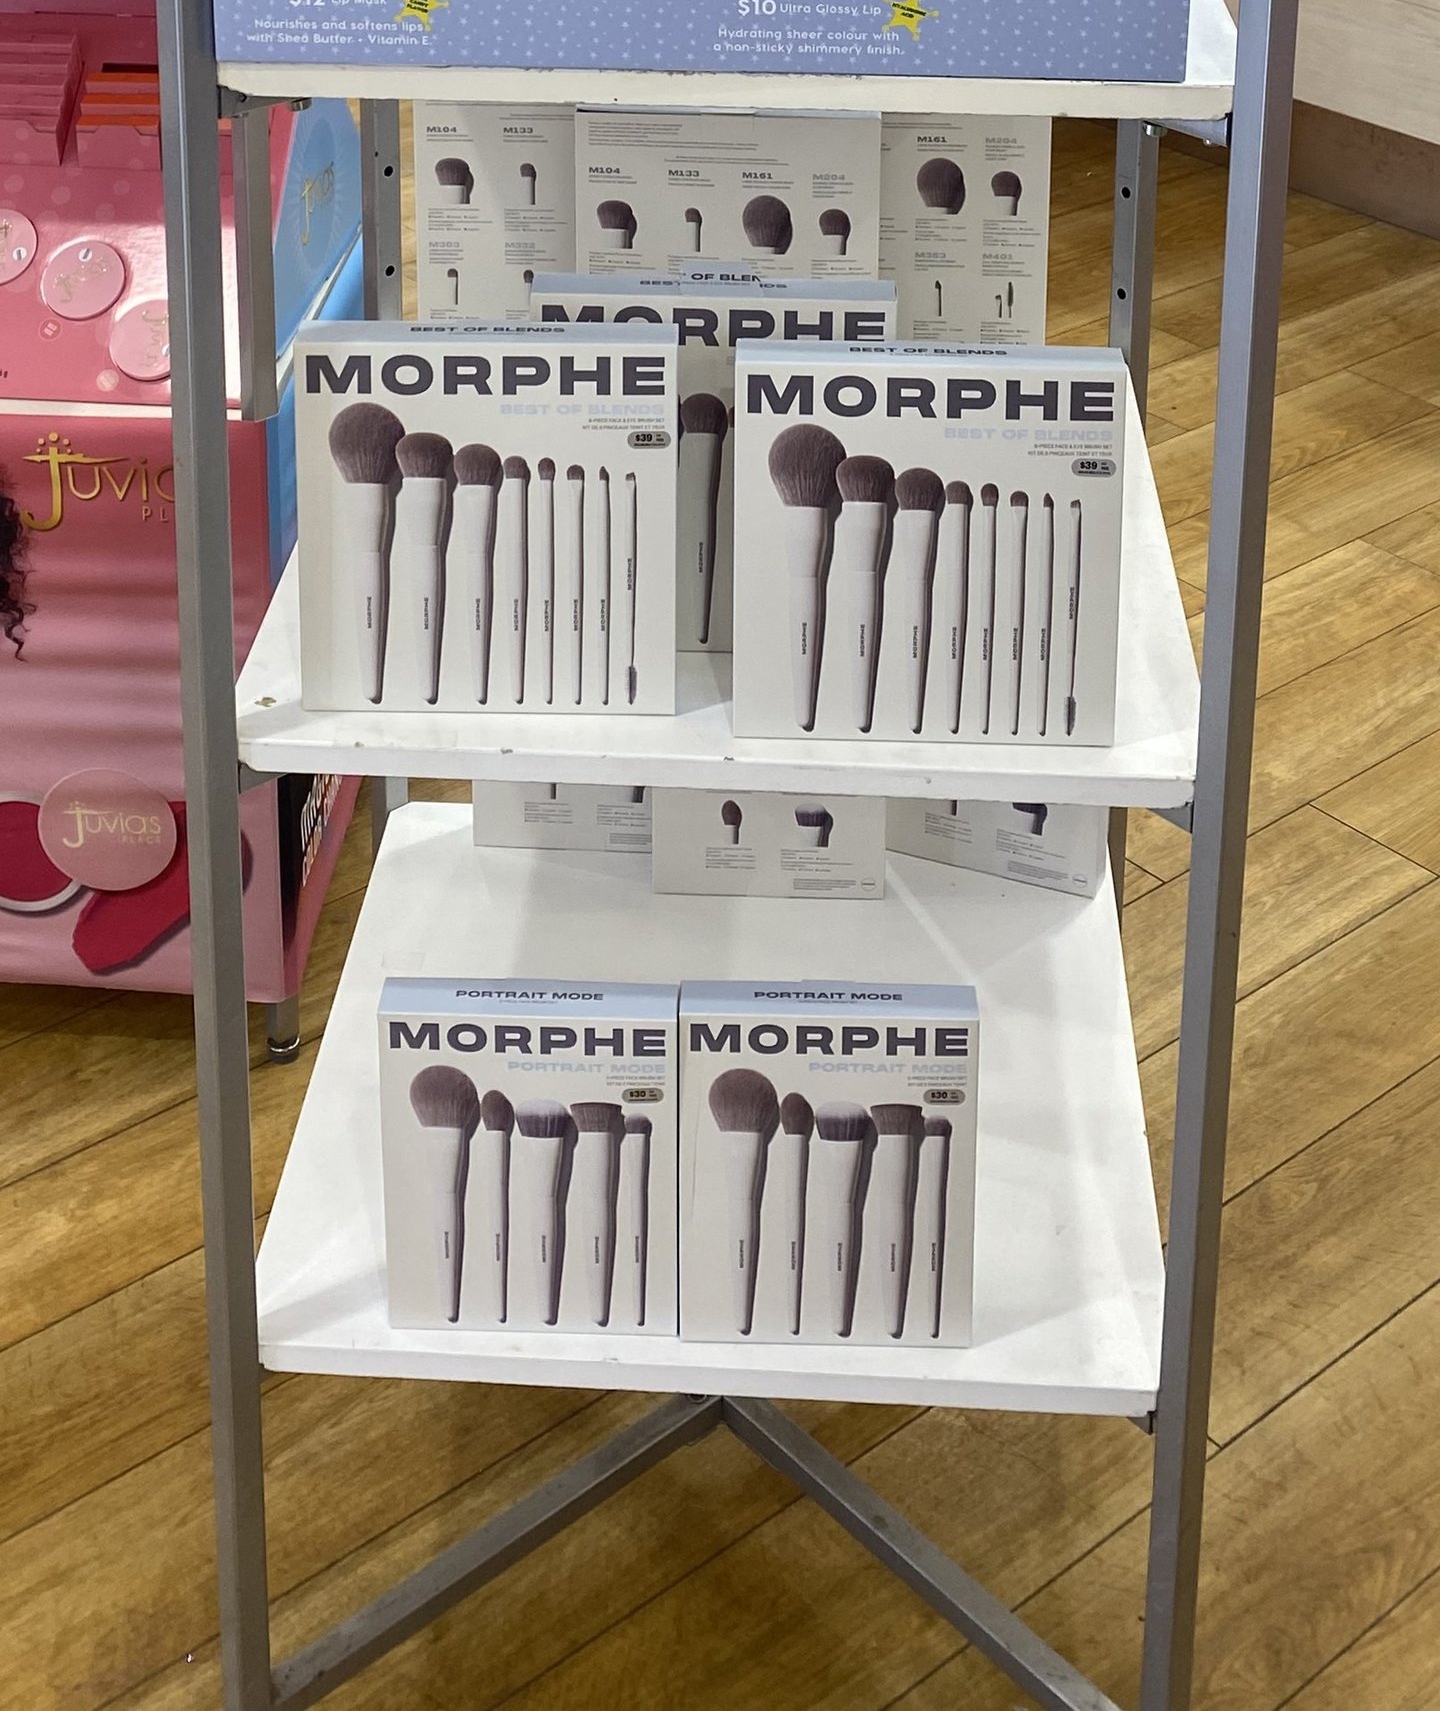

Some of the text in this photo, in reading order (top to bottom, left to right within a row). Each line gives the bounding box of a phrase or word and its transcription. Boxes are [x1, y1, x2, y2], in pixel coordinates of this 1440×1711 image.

[780, 3, 812, 14] Ultra
[815, 3, 858, 17] Glossy
[863, 4, 882, 17] Lip
[254, 18, 424, 32] Nourishes and softens lips
[247, 33, 418, 46] with Shea Butter Vitamin
[718, 28, 899, 41] Hydrating sheer colour with
[713, 42, 905, 56] a non-sticky shimmery finish.
[668, 169, 700, 178] M133
[742, 172, 773, 180] M161
[812, 173, 845, 181] M204
[933, 347, 1007, 356] BLENDS
[305, 354, 666, 396] MORPHE
[747, 374, 1115, 422] MORPHE
[501, 404, 665, 416] BEST OF BLENDS
[635, 433, 653, 442] $39
[943, 427, 1114, 442] BEST OF BLENDS
[1079, 461, 1098, 470] $39
[455, 989, 604, 1001] PORTRAIT MODE
[754, 991, 903, 1001] PORTRAIT MODE
[389, 1021, 666, 1057] MORPHE
[690, 1023, 969, 1057] MORPHE
[507, 1060, 665, 1074] PORTRAIT MODE
[808, 1062, 967, 1074] PORTRAIT MODE
